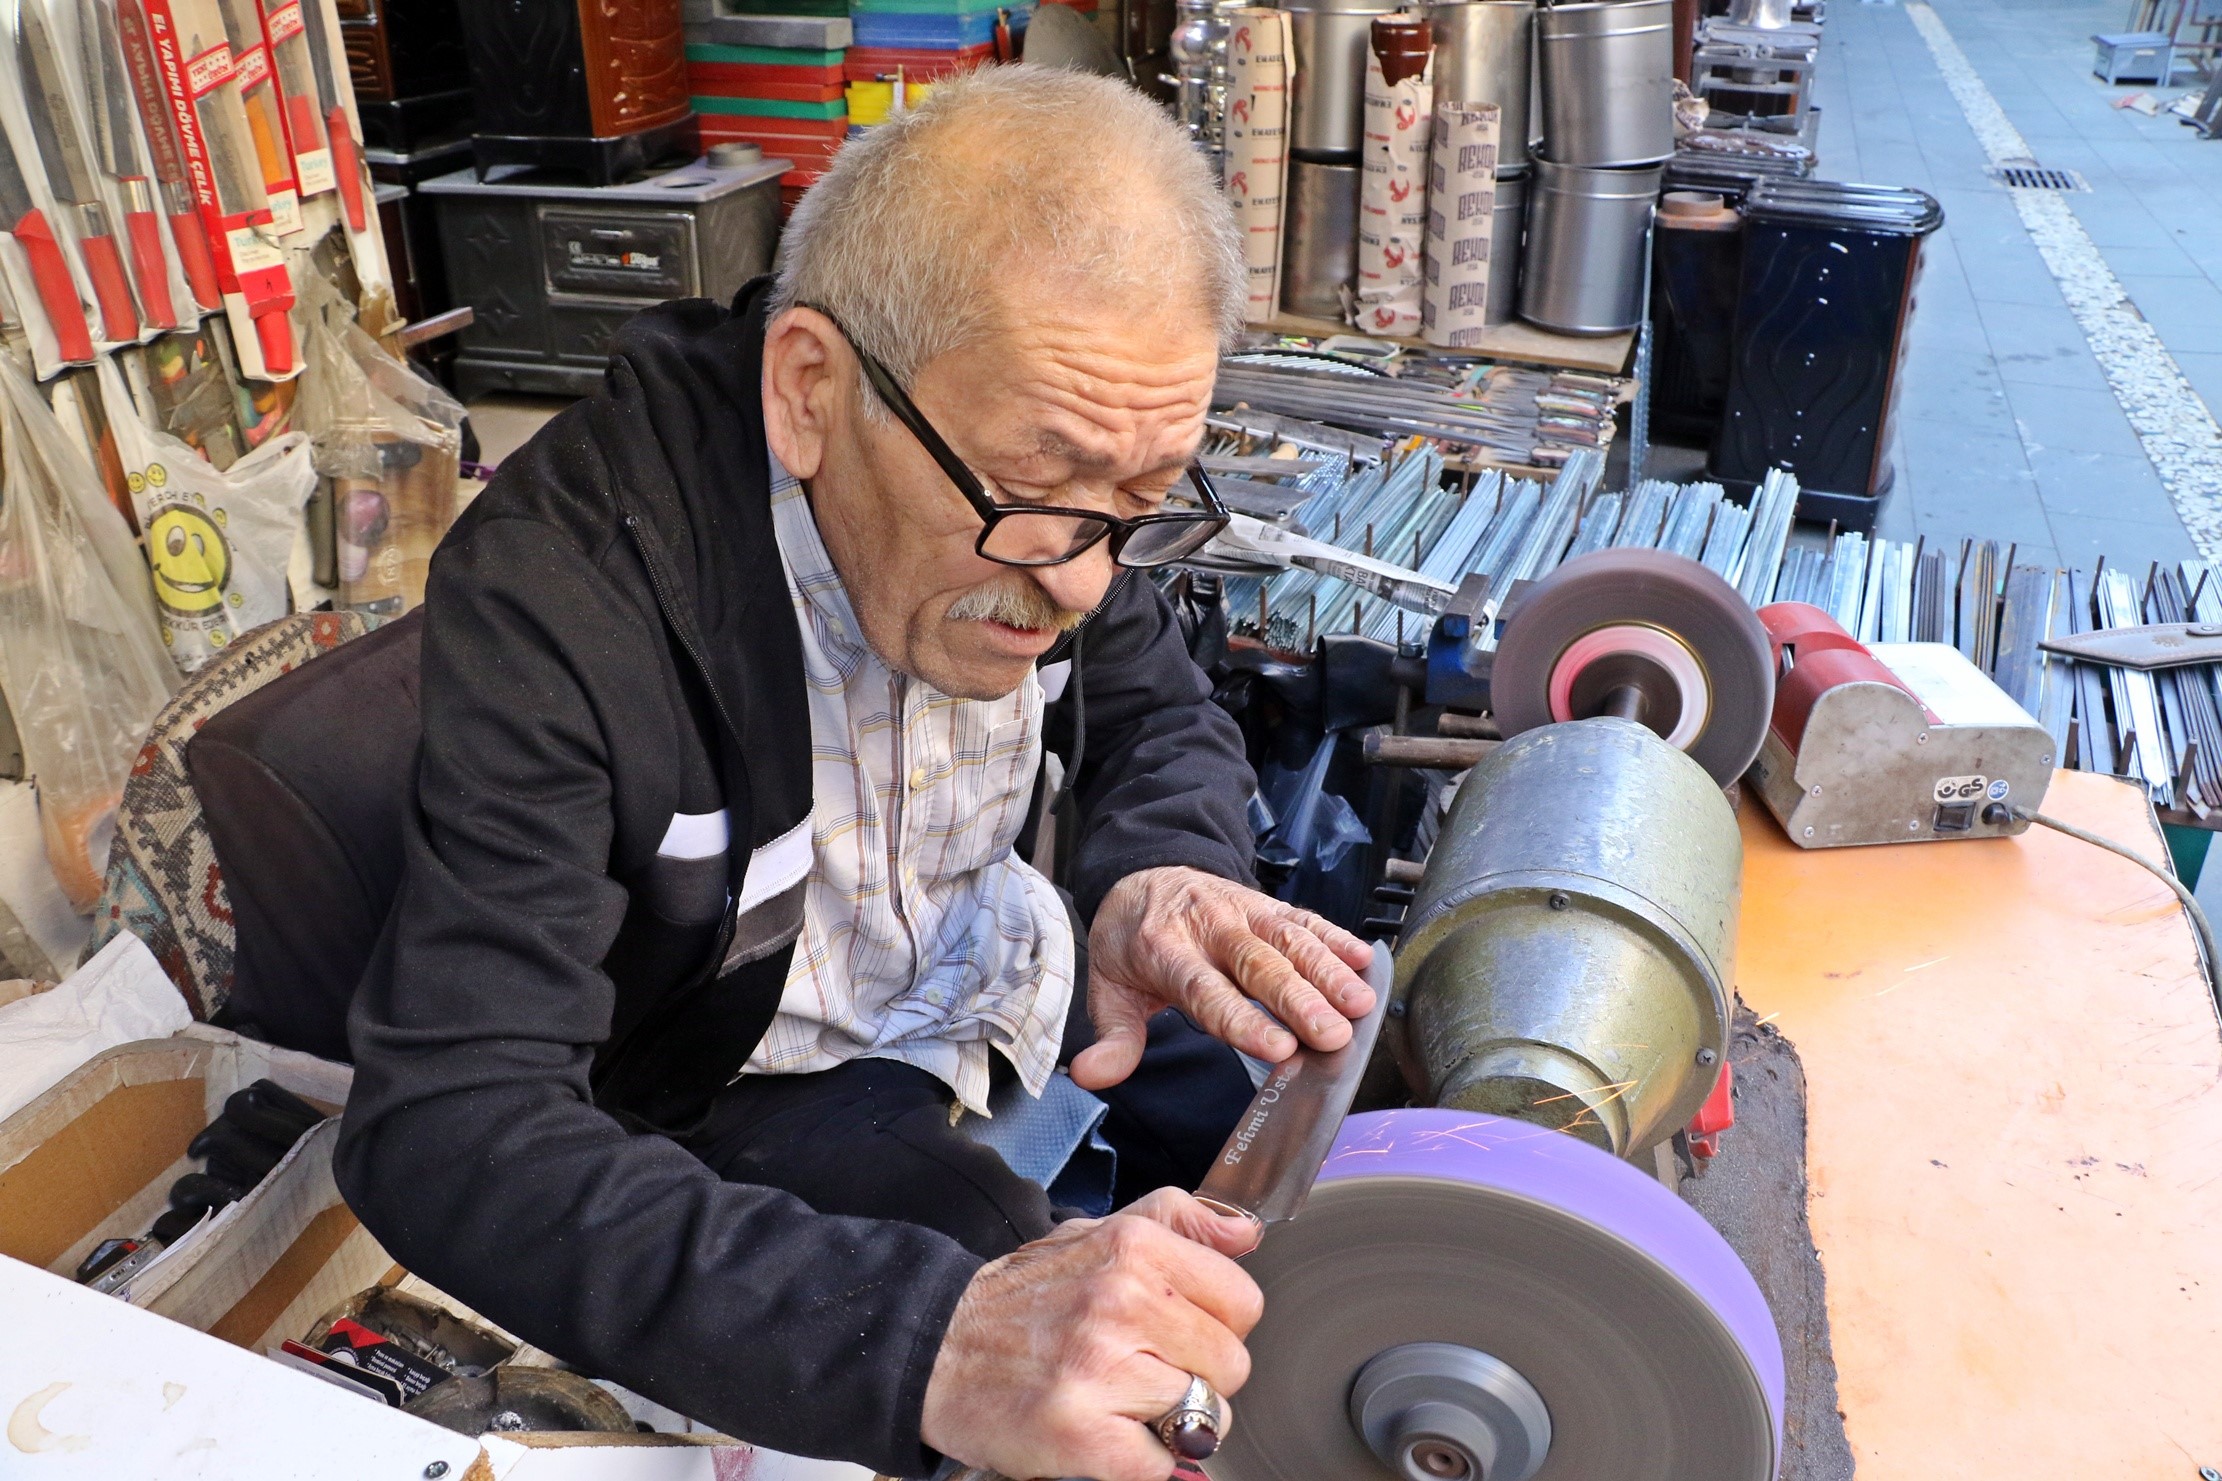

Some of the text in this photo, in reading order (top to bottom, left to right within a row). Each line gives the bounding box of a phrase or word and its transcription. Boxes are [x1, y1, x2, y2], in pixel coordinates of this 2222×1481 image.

[151, 13, 212, 206] EL YAPIMI DÖVME ÇELİK
[1958, 778, 1983, 797] GS
[1224, 1109, 1269, 1165] Fehmi
